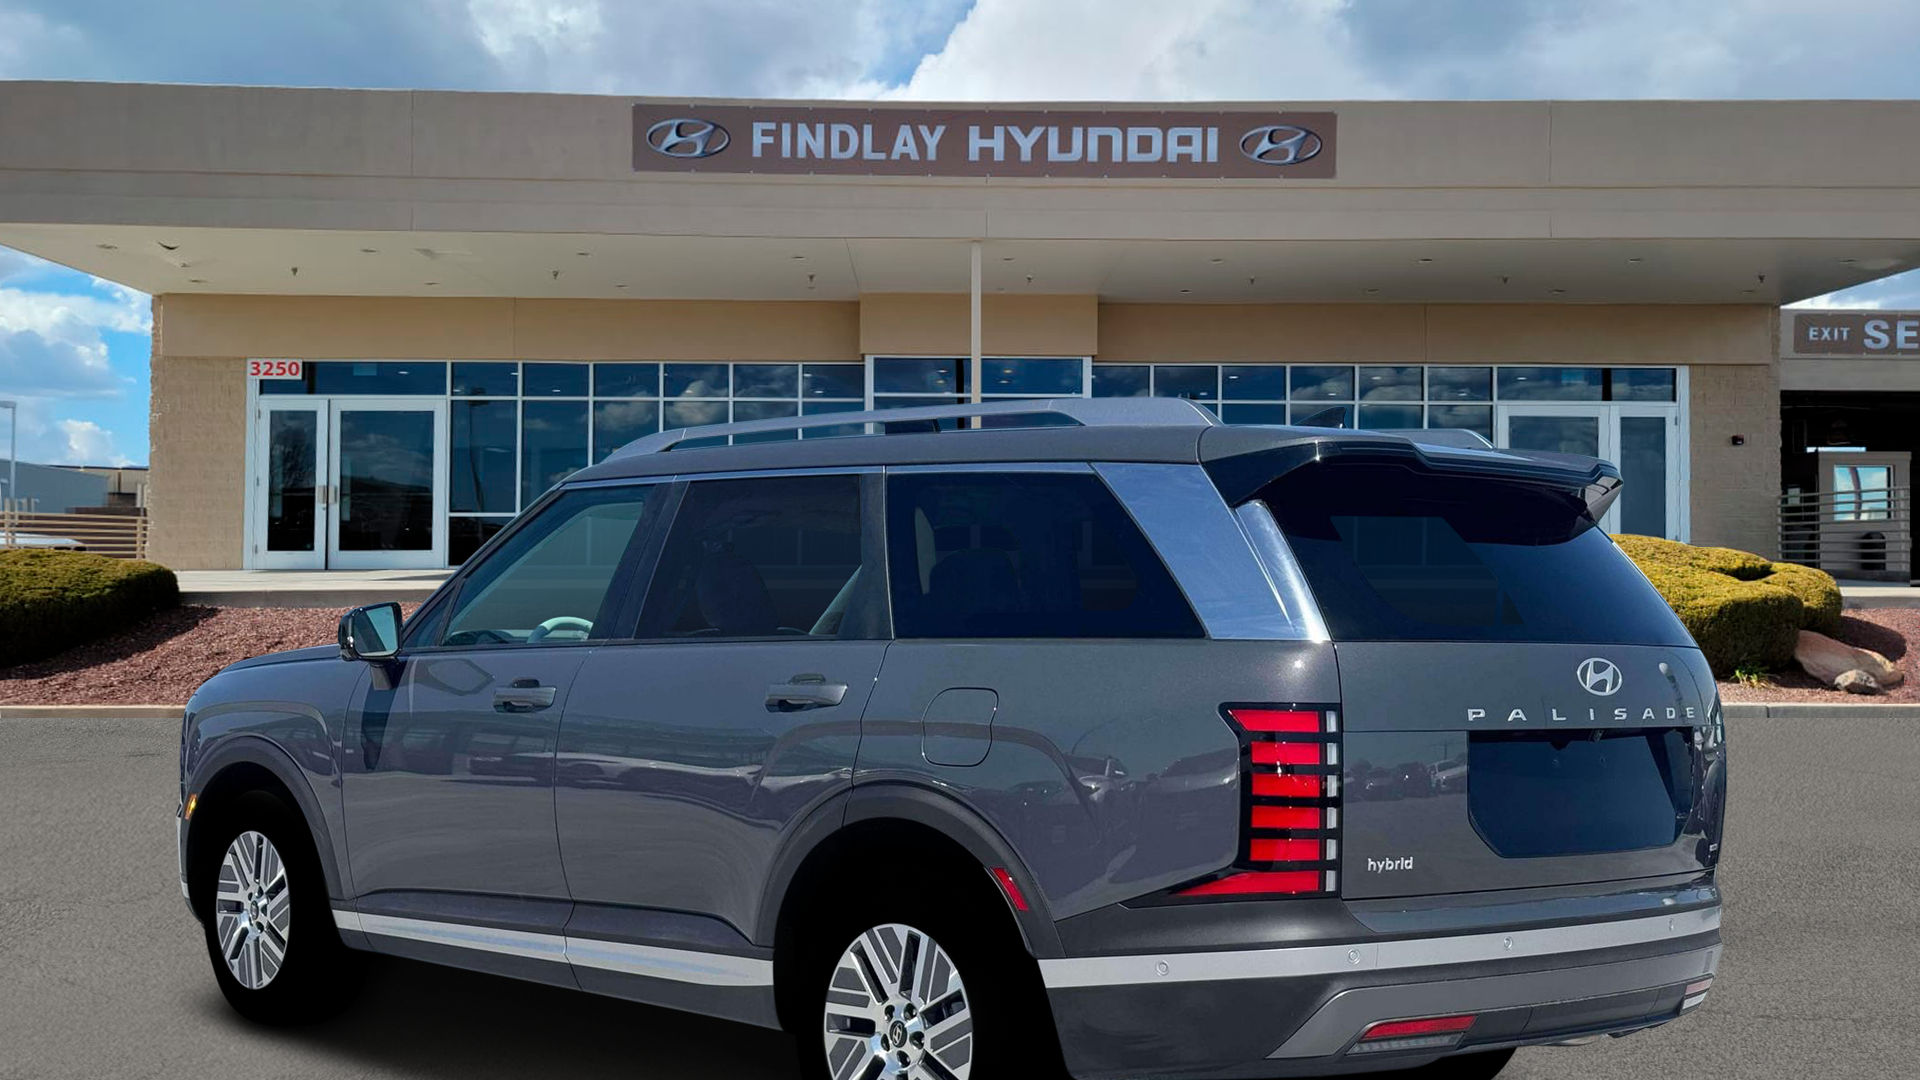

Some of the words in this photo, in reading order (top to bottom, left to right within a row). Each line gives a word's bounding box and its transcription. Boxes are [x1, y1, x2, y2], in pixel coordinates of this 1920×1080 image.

[752, 121, 946, 161] FINDLAY
[968, 125, 1218, 163] HYUNDAI
[1809, 327, 1850, 341] EXIT
[250, 361, 300, 376] 3250
[1467, 706, 1696, 722] PALISADE
[1367, 856, 1414, 874] hybrid
